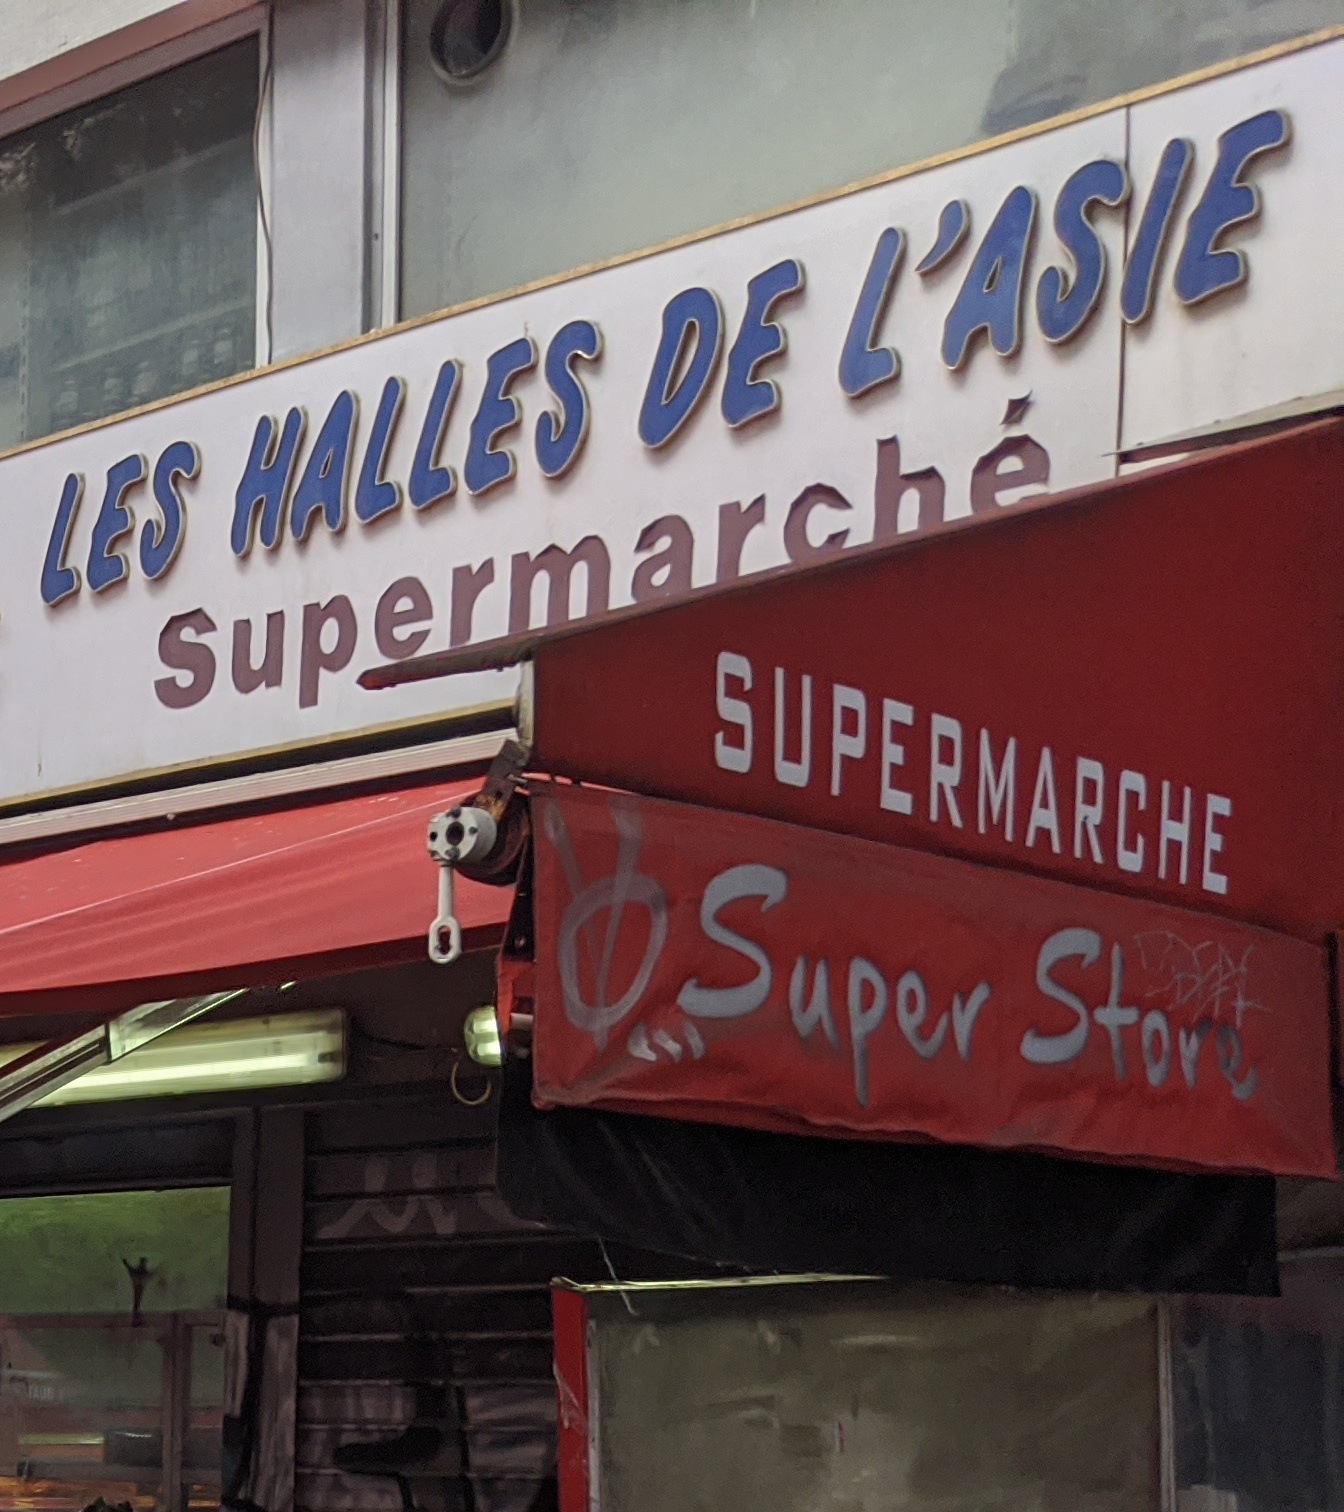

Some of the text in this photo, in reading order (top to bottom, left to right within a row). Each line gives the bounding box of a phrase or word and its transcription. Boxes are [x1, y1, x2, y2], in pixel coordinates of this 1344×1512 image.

[41, 109, 1291, 608] LES HALLES DE L'ASIE
[153, 391, 1053, 710] Supermarché
[715, 650, 1233, 896] SUPERMARCHE
[675, 863, 992, 1108] Super
[1019, 927, 1260, 1101] Store
